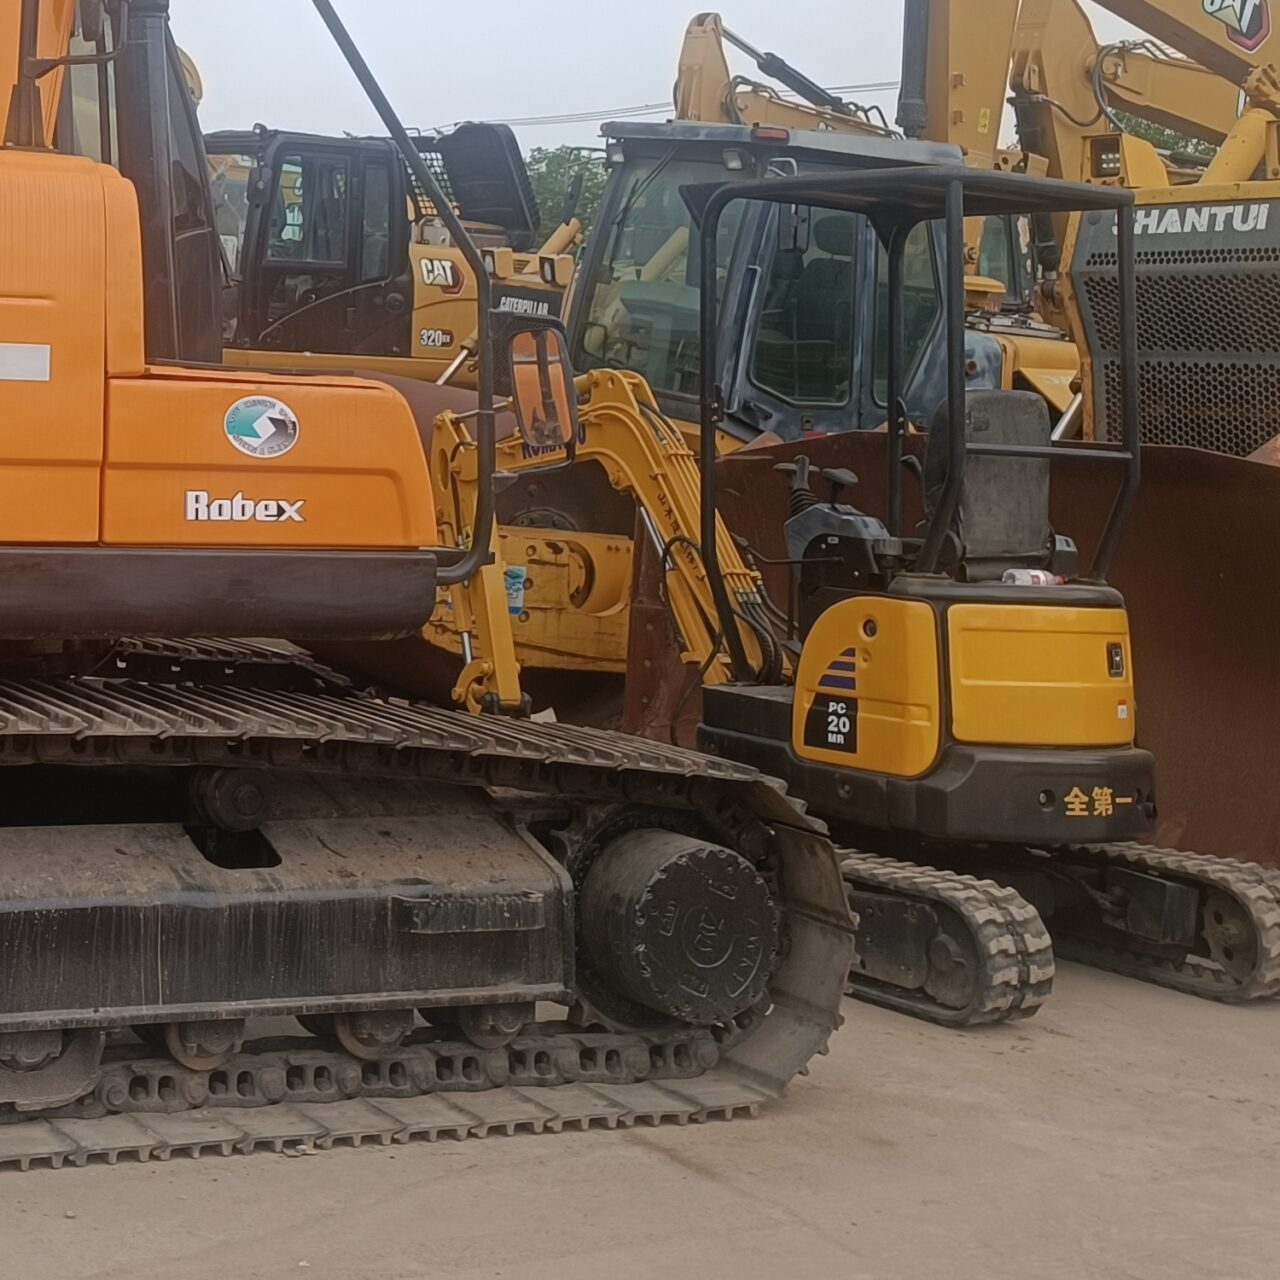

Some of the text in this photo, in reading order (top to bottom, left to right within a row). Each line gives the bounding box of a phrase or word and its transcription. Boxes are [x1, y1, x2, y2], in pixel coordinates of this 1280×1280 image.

[421, 259, 453, 286] CAT
[186, 490, 305, 522] Robex
[828, 701, 847, 715] PC
[827, 715, 850, 733] 20
[827, 732, 845, 744] MR
[1063, 786, 1133, 817] 全第一
